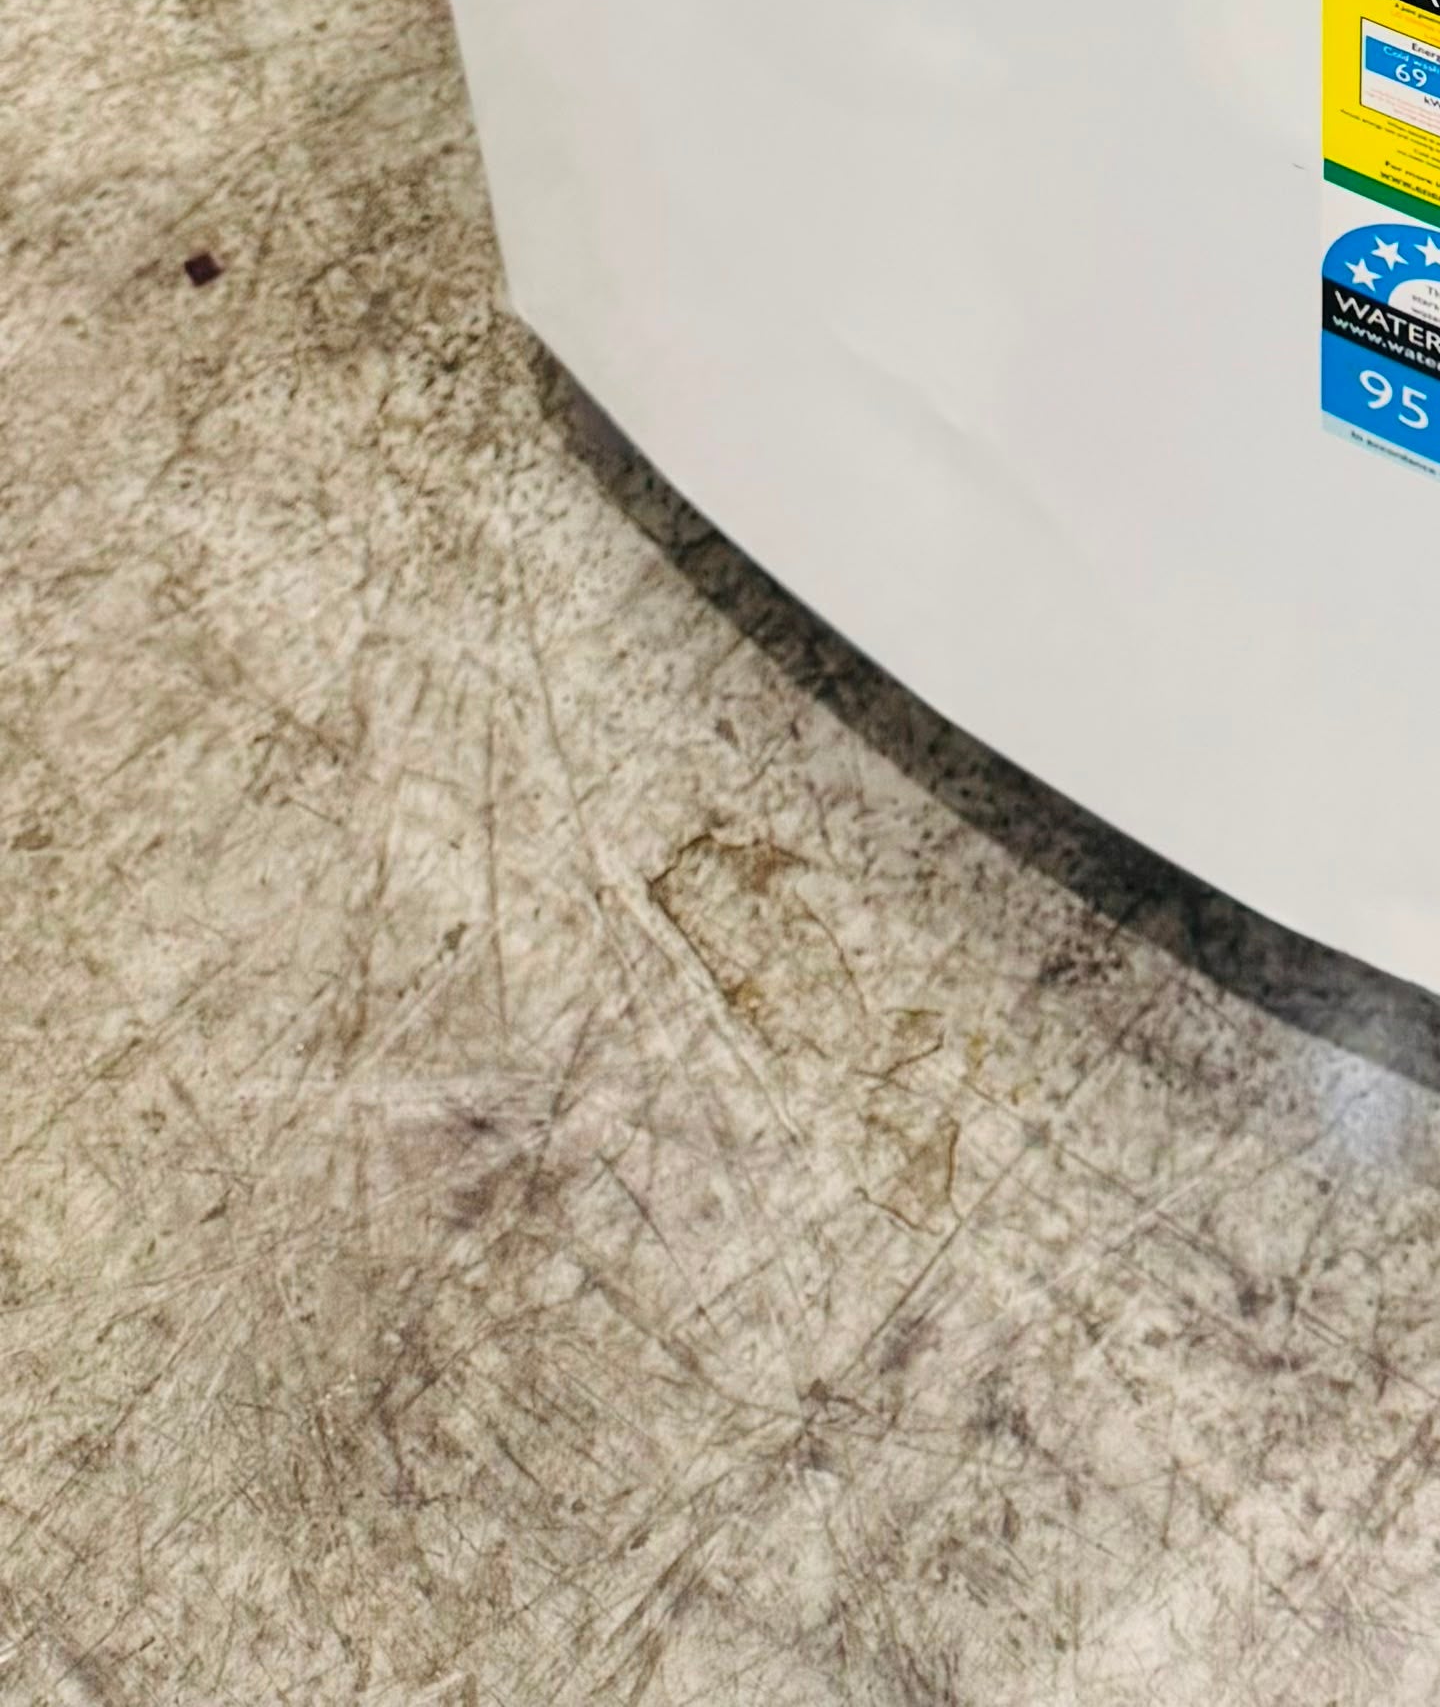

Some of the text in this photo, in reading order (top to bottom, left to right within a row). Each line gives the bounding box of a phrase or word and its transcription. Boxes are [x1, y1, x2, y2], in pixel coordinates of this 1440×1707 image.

[1383, 45, 1410, 64] Cold
[1413, 60, 1440, 75] wash
[1395, 63, 1427, 88] 69
[1358, 369, 1430, 430] 95
